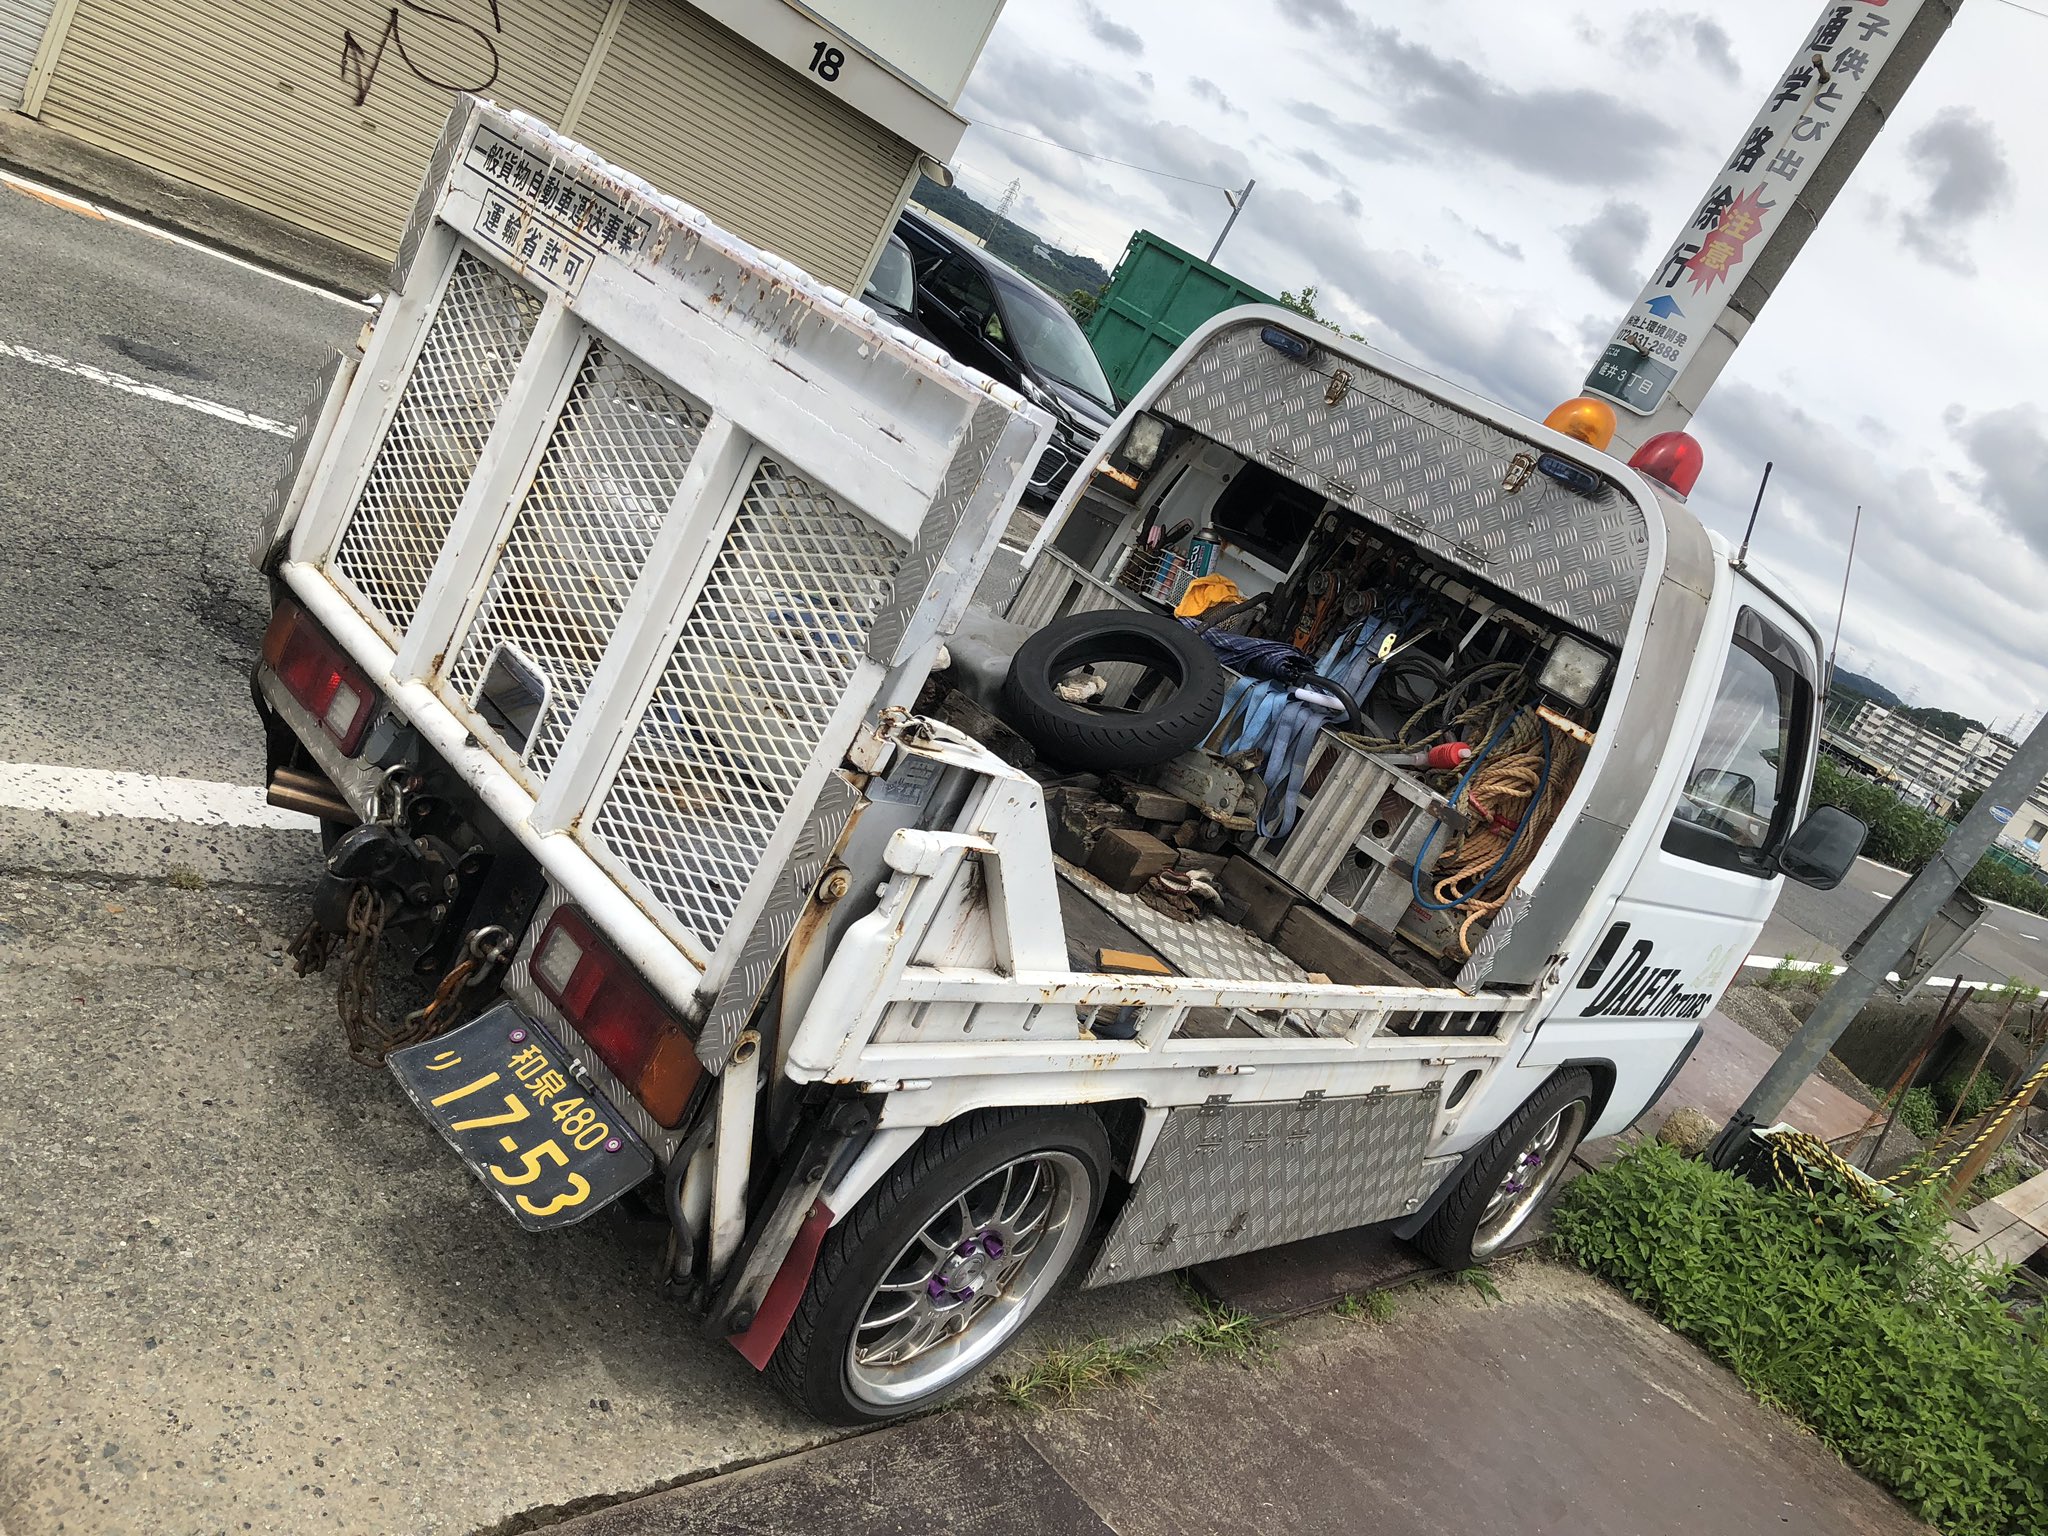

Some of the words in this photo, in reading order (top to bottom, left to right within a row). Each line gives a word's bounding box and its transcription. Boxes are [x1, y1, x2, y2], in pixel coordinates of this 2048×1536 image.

[809, 41, 845, 82] 18
[1655, 6, 1853, 288] 通学路徐行
[1756, 13, 1891, 209] 子供とび出し
[475, 142, 643, 255] 一般貨物自動車運送事業
[1699, 208, 1755, 271] 注意
[483, 200, 585, 286] 運輸省許可
[1579, 939, 1682, 1017] DAIEI
[425, 1050, 462, 1071] り
[431, 1072, 591, 1216] 17-53
[551, 1097, 609, 1151] 480
